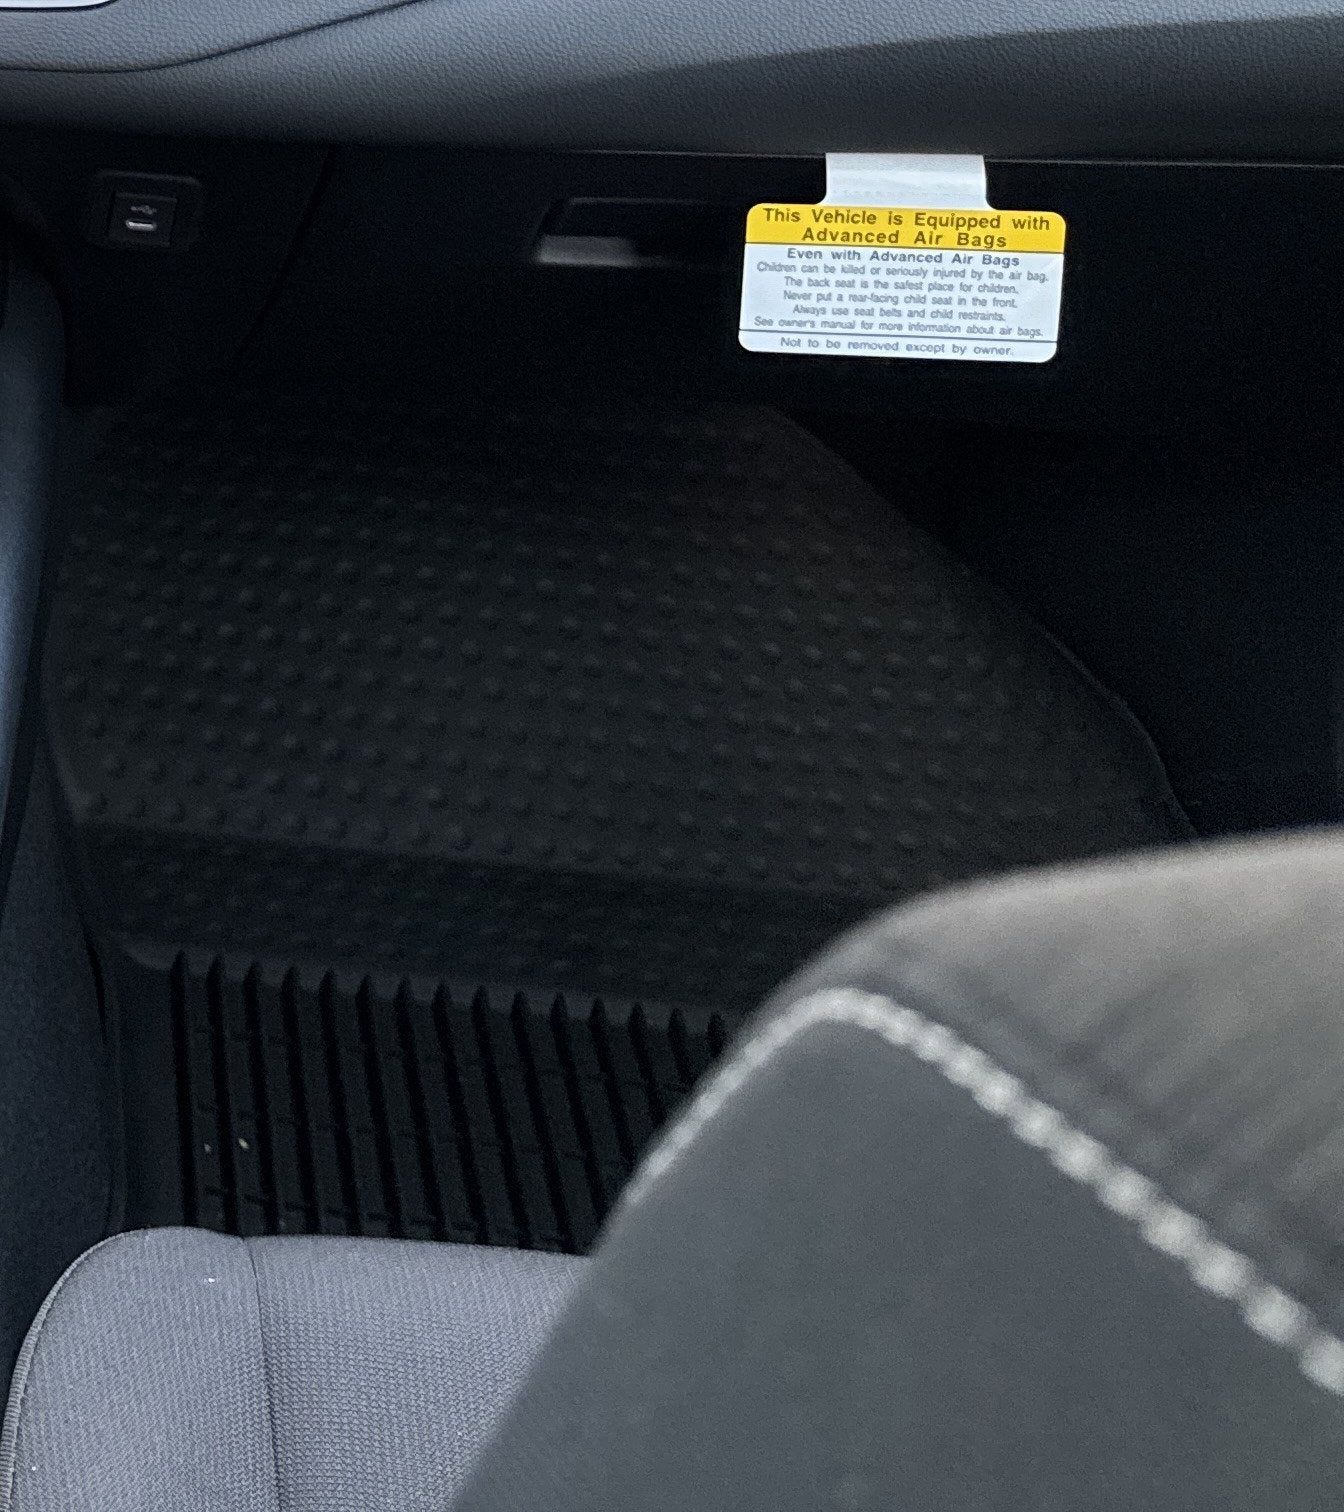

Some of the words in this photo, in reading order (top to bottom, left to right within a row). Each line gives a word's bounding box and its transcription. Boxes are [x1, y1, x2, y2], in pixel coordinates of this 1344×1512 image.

[763, 208, 800, 222] This
[812, 209, 877, 225] Vehicle
[888, 211, 903, 225] is
[915, 213, 1001, 230] Equipped
[1012, 215, 1050, 230] with
[802, 227, 899, 244] Advanced
[914, 231, 943, 245] Air
[957, 233, 1007, 249] Bags
[788, 248, 822, 259] Even
[831, 250, 861, 260] with
[870, 250, 943, 263] Advanced
[951, 254, 974, 264] Air
[982, 254, 1020, 268] Bags
[757, 261, 796, 273] Children
[801, 265, 818, 273] can
[824, 264, 836, 274] be
[841, 265, 865, 274] killed
[871, 266, 881, 275] or
[886, 266, 928, 278] seriously
[933, 268, 965, 279] injured
[971, 269, 983, 280] by
[989, 270, 1003, 279] the
[1009, 271, 1022, 280] air
[1027, 271, 1048, 283] bag.
[784, 276, 802, 286] The
[808, 277, 830, 287] back
[835, 279, 855, 288] seat
[861, 279, 868, 288] is
[874, 280, 888, 289] the
[894, 280, 923, 290] safest
[928, 282, 953, 292] place
[960, 282, 972, 292] for
[978, 284, 1019, 294] children.
[784, 291, 811, 301] Never
[816, 292, 832, 302] put
[849, 293, 899, 305] rear-facing
[904, 294, 926, 304] child
[932, 296, 952, 305] seat
[958, 296, 966, 305] in
[972, 297, 987, 306] the
[993, 297, 1017, 308] front.
[793, 305, 826, 316] Always
[832, 307, 848, 315] use
[854, 307, 874, 316] seat
[879, 307, 901, 317] belts
[907, 309, 925, 318] and
[931, 310, 953, 319] child
[754, 316, 773, 326] See
[778, 318, 815, 328] owner's
[821, 320, 855, 329] manual
[861, 321, 873, 329] for
[879, 322, 902, 331] more
[909, 322, 961, 332] information
[966, 325, 994, 334] about
[999, 326, 1012, 335] air
[1018, 326, 1043, 338] bags.
[781, 337, 801, 347] Not
[808, 338, 819, 348] to
[826, 339, 840, 349] be
[848, 342, 899, 351] removed
[906, 343, 945, 354] except
[952, 344, 966, 355] by
